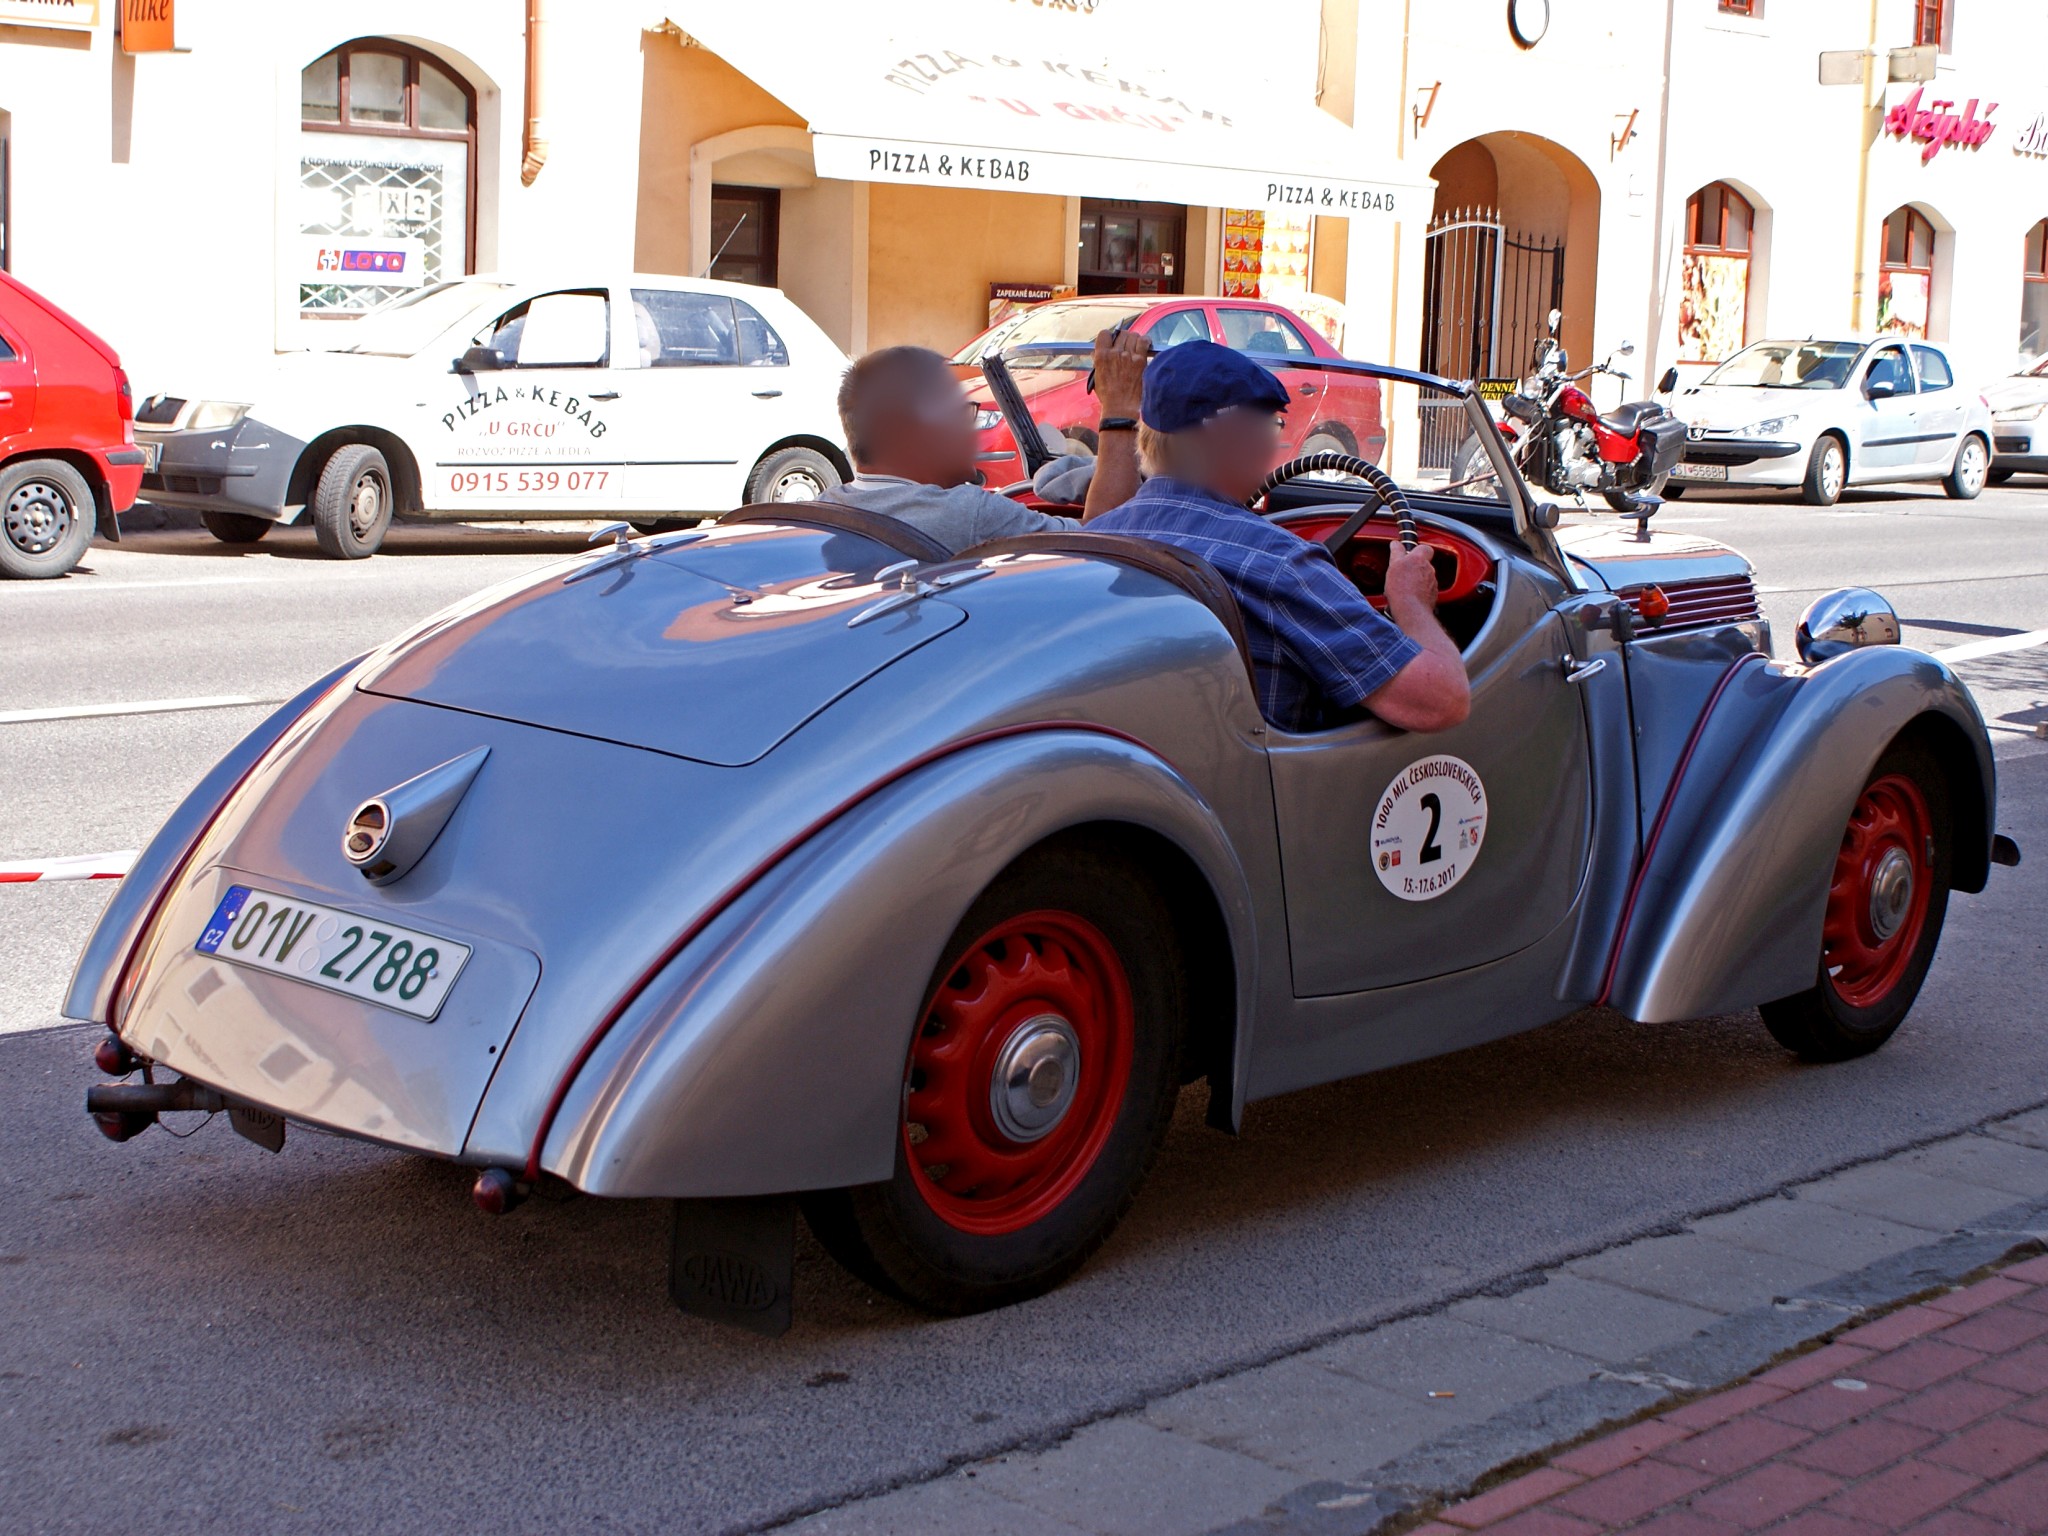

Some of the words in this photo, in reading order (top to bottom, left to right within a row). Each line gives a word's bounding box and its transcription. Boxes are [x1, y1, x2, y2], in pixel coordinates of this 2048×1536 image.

[884, 50, 984, 94] PIZZA
[869, 149, 930, 173] PIZZA
[938, 155, 953, 176] &
[961, 156, 1030, 182] KEBAB
[1267, 183, 1314, 205] PIZZA
[1321, 187, 1334, 207] &
[1339, 189, 1395, 212] KEBAB
[343, 252, 404, 270] LOTO
[996, 288, 1028, 298] ZAPEKANÉ
[1028, 290, 1051, 298] BAGETY
[1480, 381, 1516, 392] DENNÉ
[442, 386, 508, 431] PIZZA
[516, 388, 525, 398] &
[532, 385, 607, 438] KEBAB
[457, 447, 506, 457] ROZVOZ
[509, 447, 540, 456] PIZZE
[545, 447, 552, 456] A
[451, 472, 508, 492] 0915
[517, 472, 560, 491] 539
[567, 471, 609, 490] 077
[1376, 797, 1394, 830] 1000
[1392, 777, 1409, 801] MIL
[1409, 761, 1482, 804] ČESKOSLOVENSKÝCH
[1419, 792, 1442, 865] 2
[203, 928, 224, 946] CZ
[231, 901, 317, 963] 01V
[320, 926, 439, 1000] 2788
